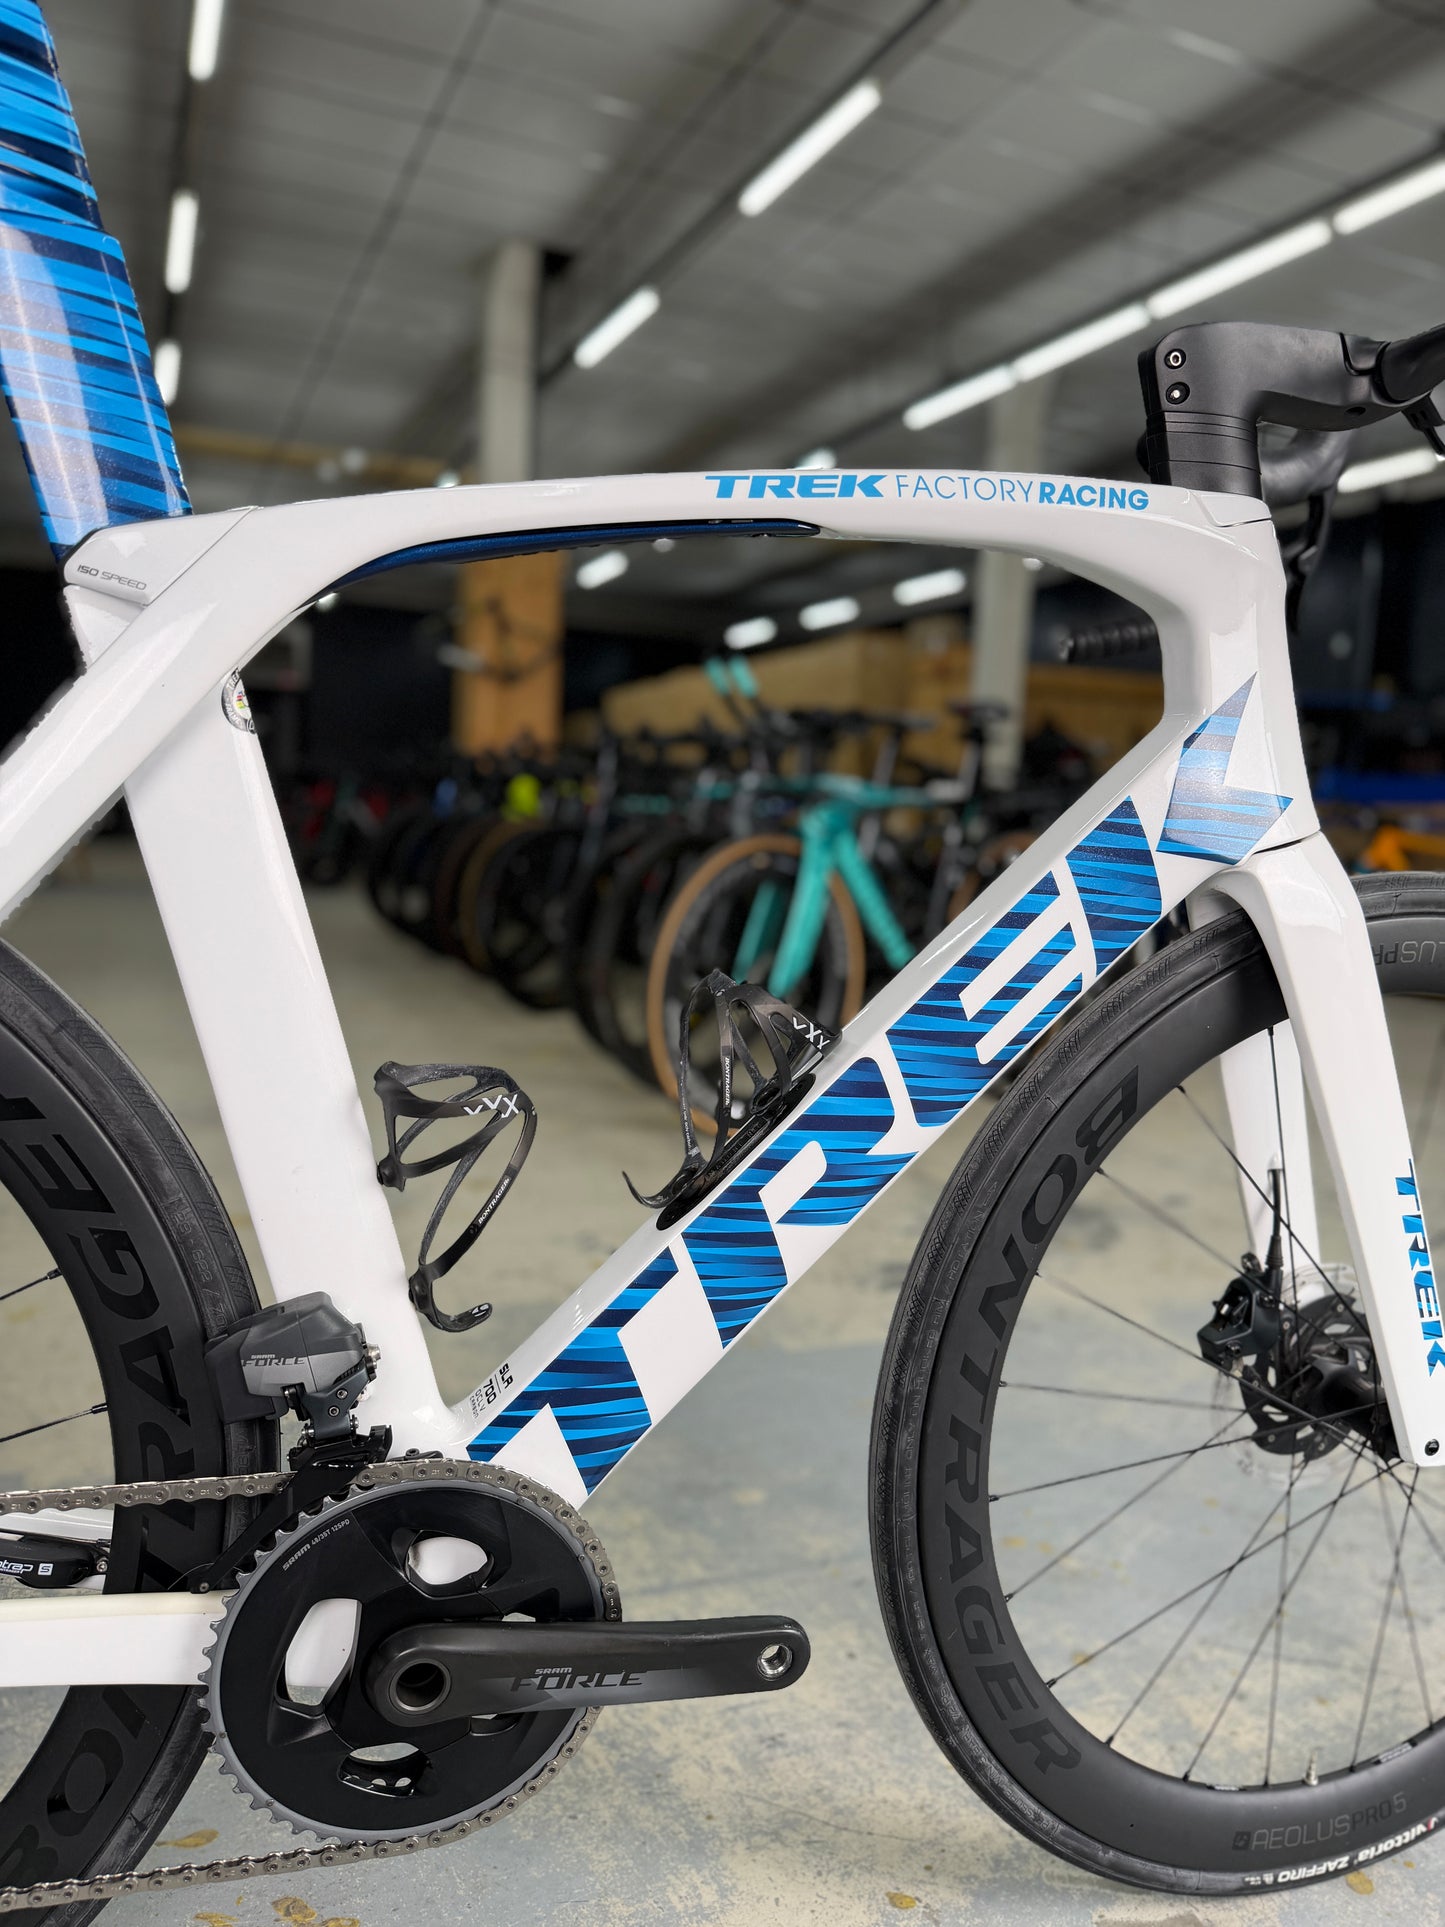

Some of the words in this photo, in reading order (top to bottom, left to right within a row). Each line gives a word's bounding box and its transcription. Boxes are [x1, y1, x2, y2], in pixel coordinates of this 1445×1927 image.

[705, 474, 887, 498] TREK
[896, 474, 1033, 503] FACTORY
[1038, 481, 1149, 511] RACING
[77, 564, 99, 577] ISO
[100, 571, 147, 591] SPEED
[468, 674, 1292, 1493] TREK
[478, 1178, 510, 1224] BONTRAGER
[1395, 1158, 1445, 1378] TREK
[241, 1357, 305, 1367] FORCE
[499, 1363, 514, 1389] SLR
[483, 1378, 497, 1404] 700
[944, 1065, 1139, 1775] BONTRAGER
[283, 1543, 311, 1571] SRAM
[331, 1519, 350, 1532] 12SPD
[510, 1672, 643, 1691] FORCE
[1278, 1856, 1350, 1883] ZAFFIRO
